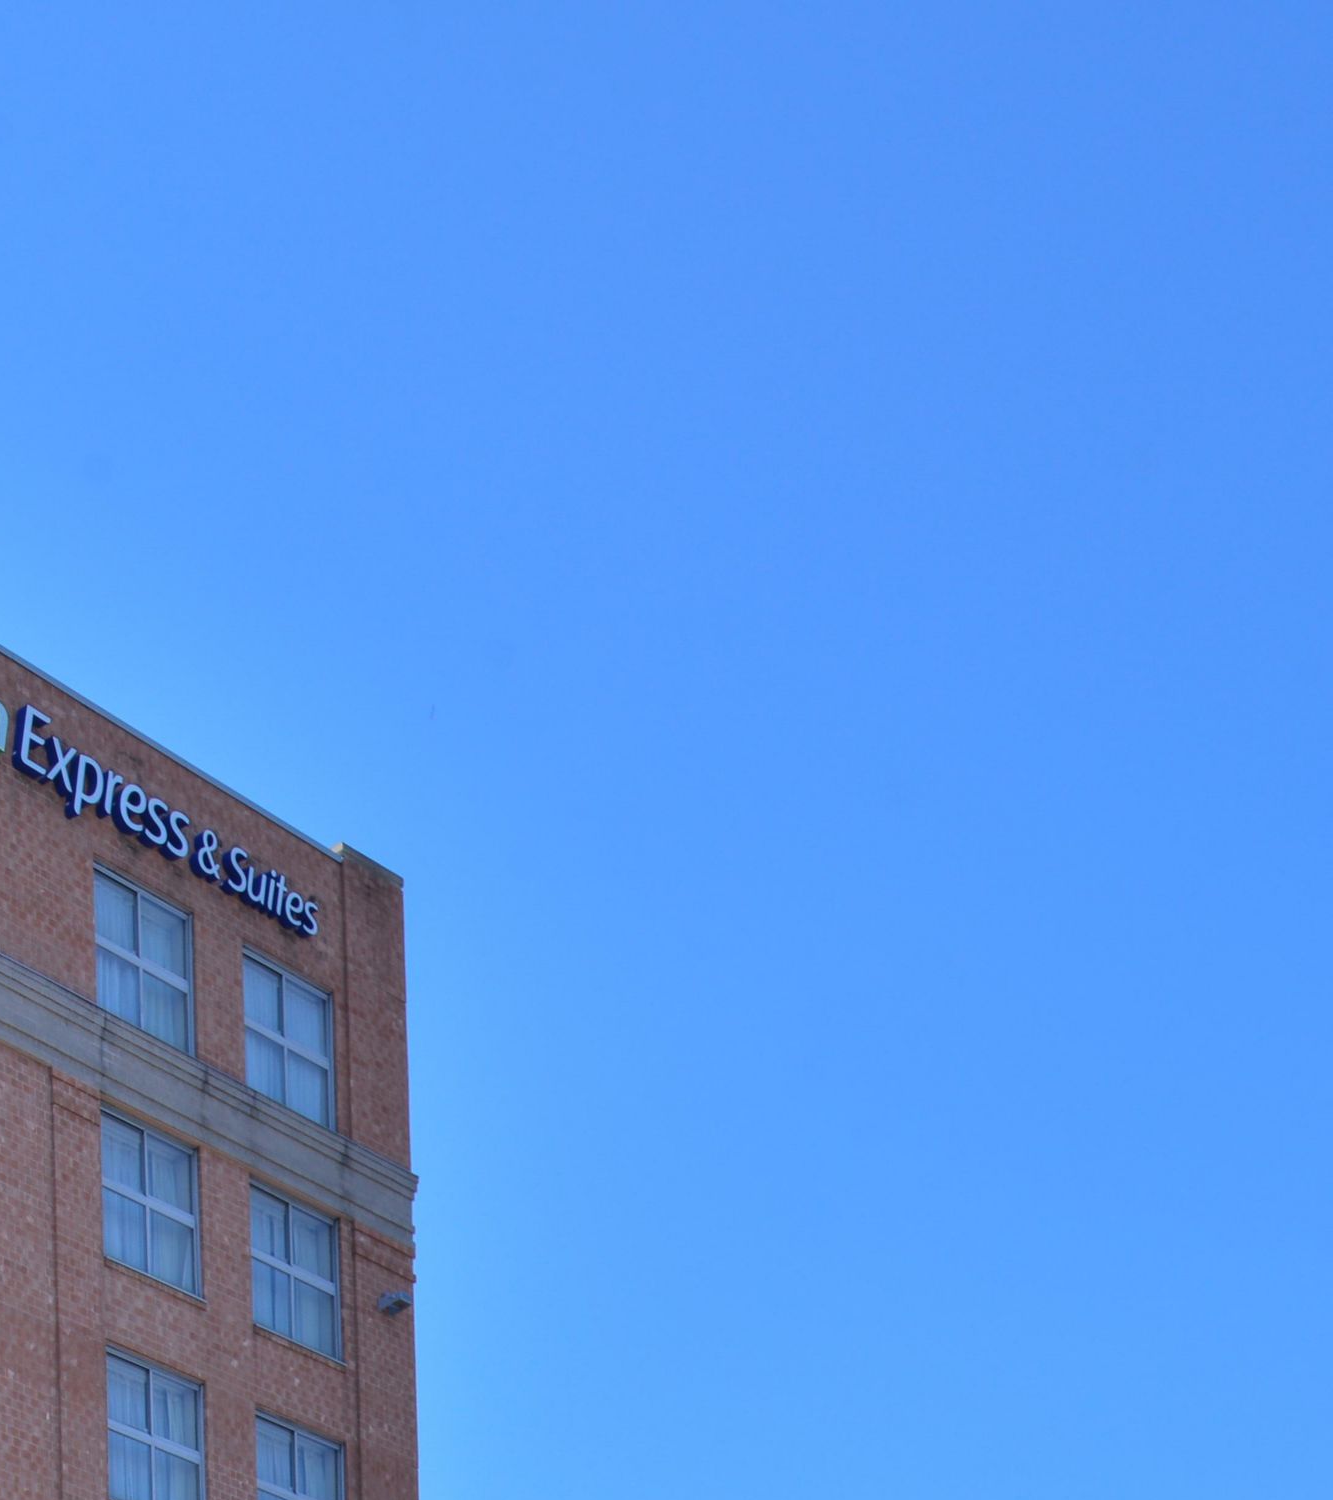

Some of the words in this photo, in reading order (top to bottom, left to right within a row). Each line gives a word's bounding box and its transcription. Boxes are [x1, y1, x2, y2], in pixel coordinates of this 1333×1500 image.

[19, 704, 190, 858] Express
[198, 829, 221, 880] &
[227, 847, 319, 936] Suites
